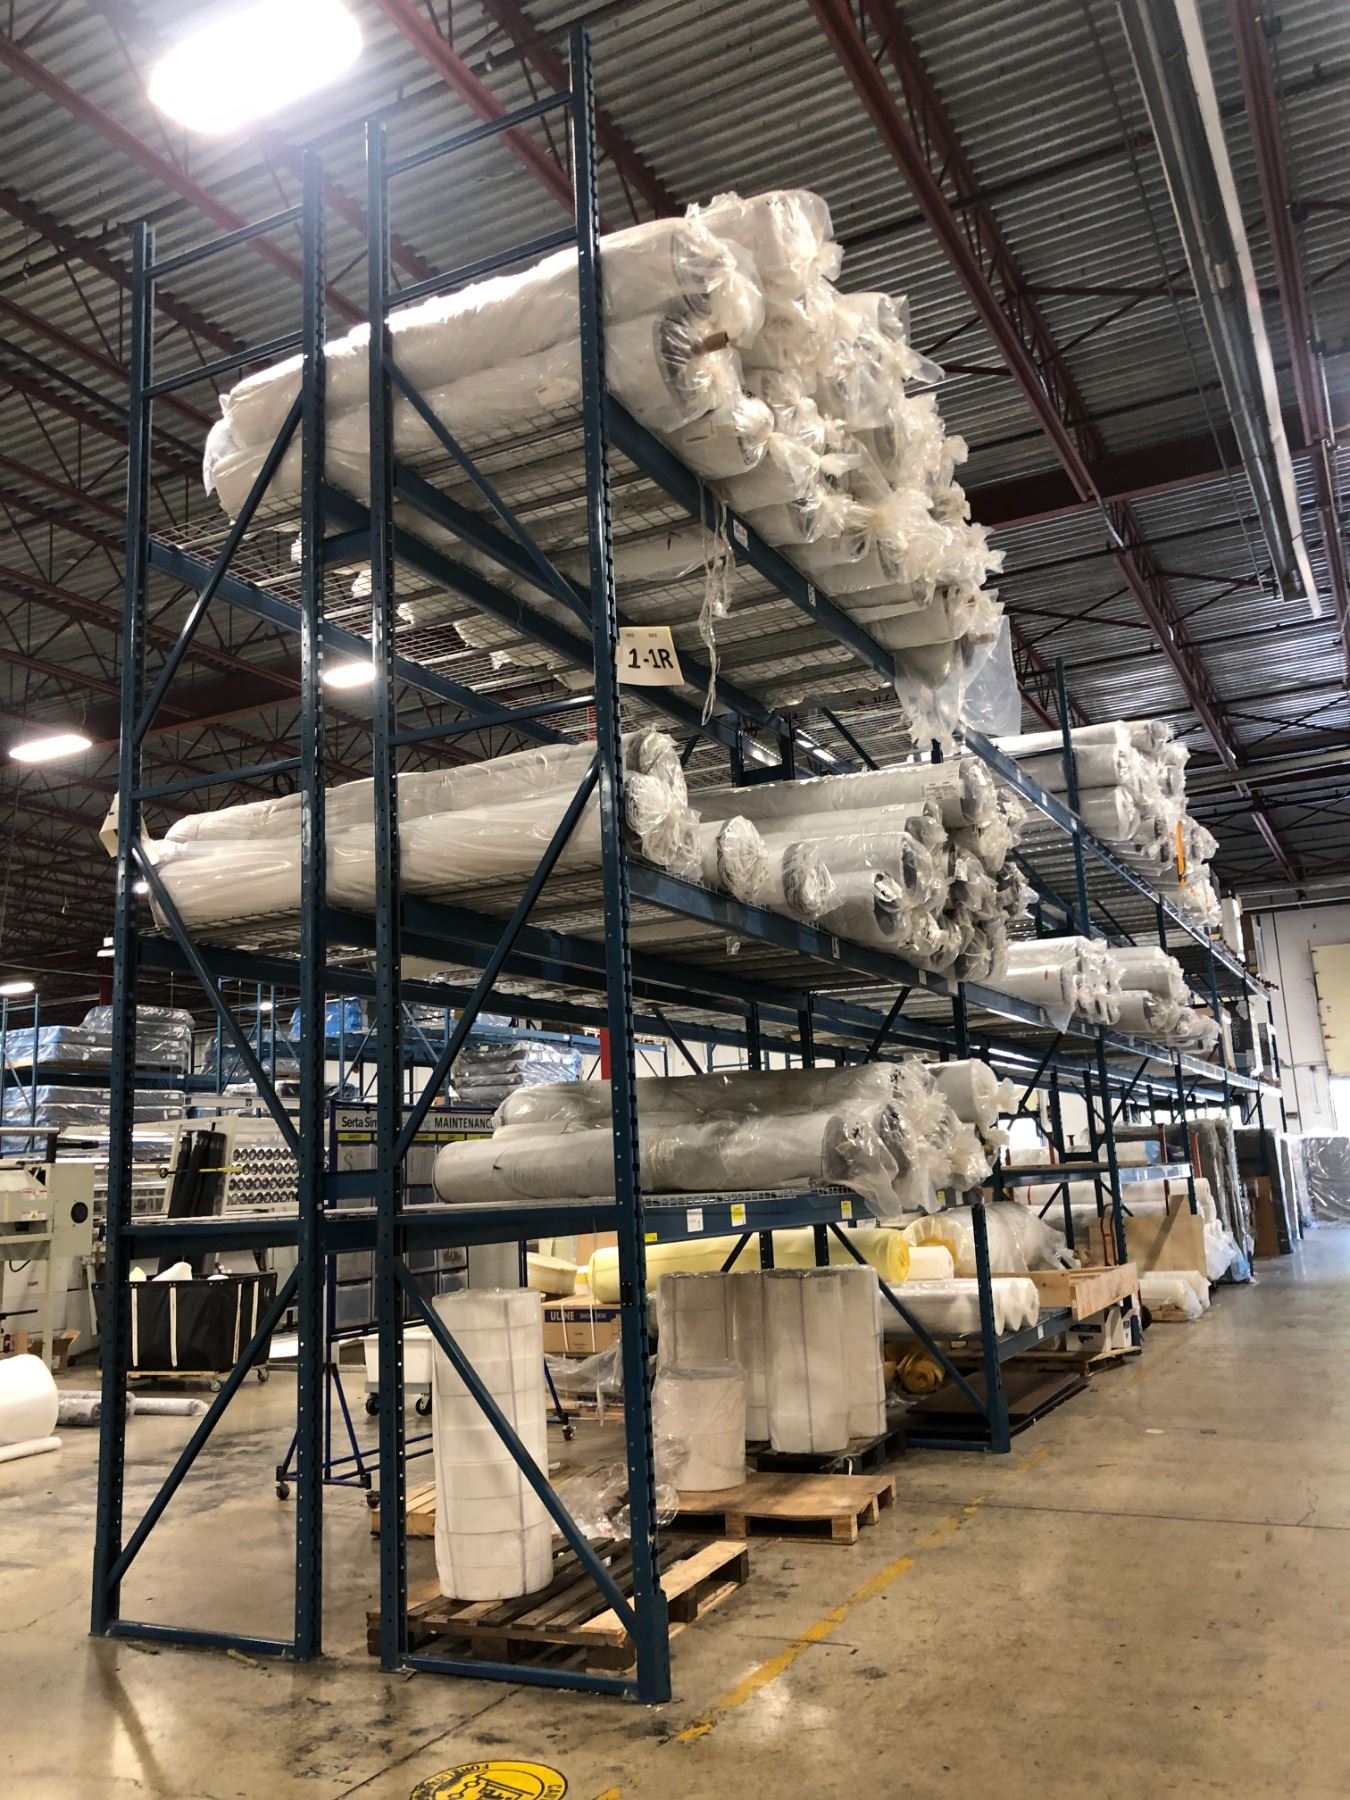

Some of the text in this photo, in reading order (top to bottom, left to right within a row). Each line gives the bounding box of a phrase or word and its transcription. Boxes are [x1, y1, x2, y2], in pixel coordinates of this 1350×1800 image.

[628, 648, 674, 669] 1-1R
[342, 1116, 364, 1128] Serta
[434, 1116, 493, 1129] MAINTENANC
[550, 1311, 575, 1321] ULNE
